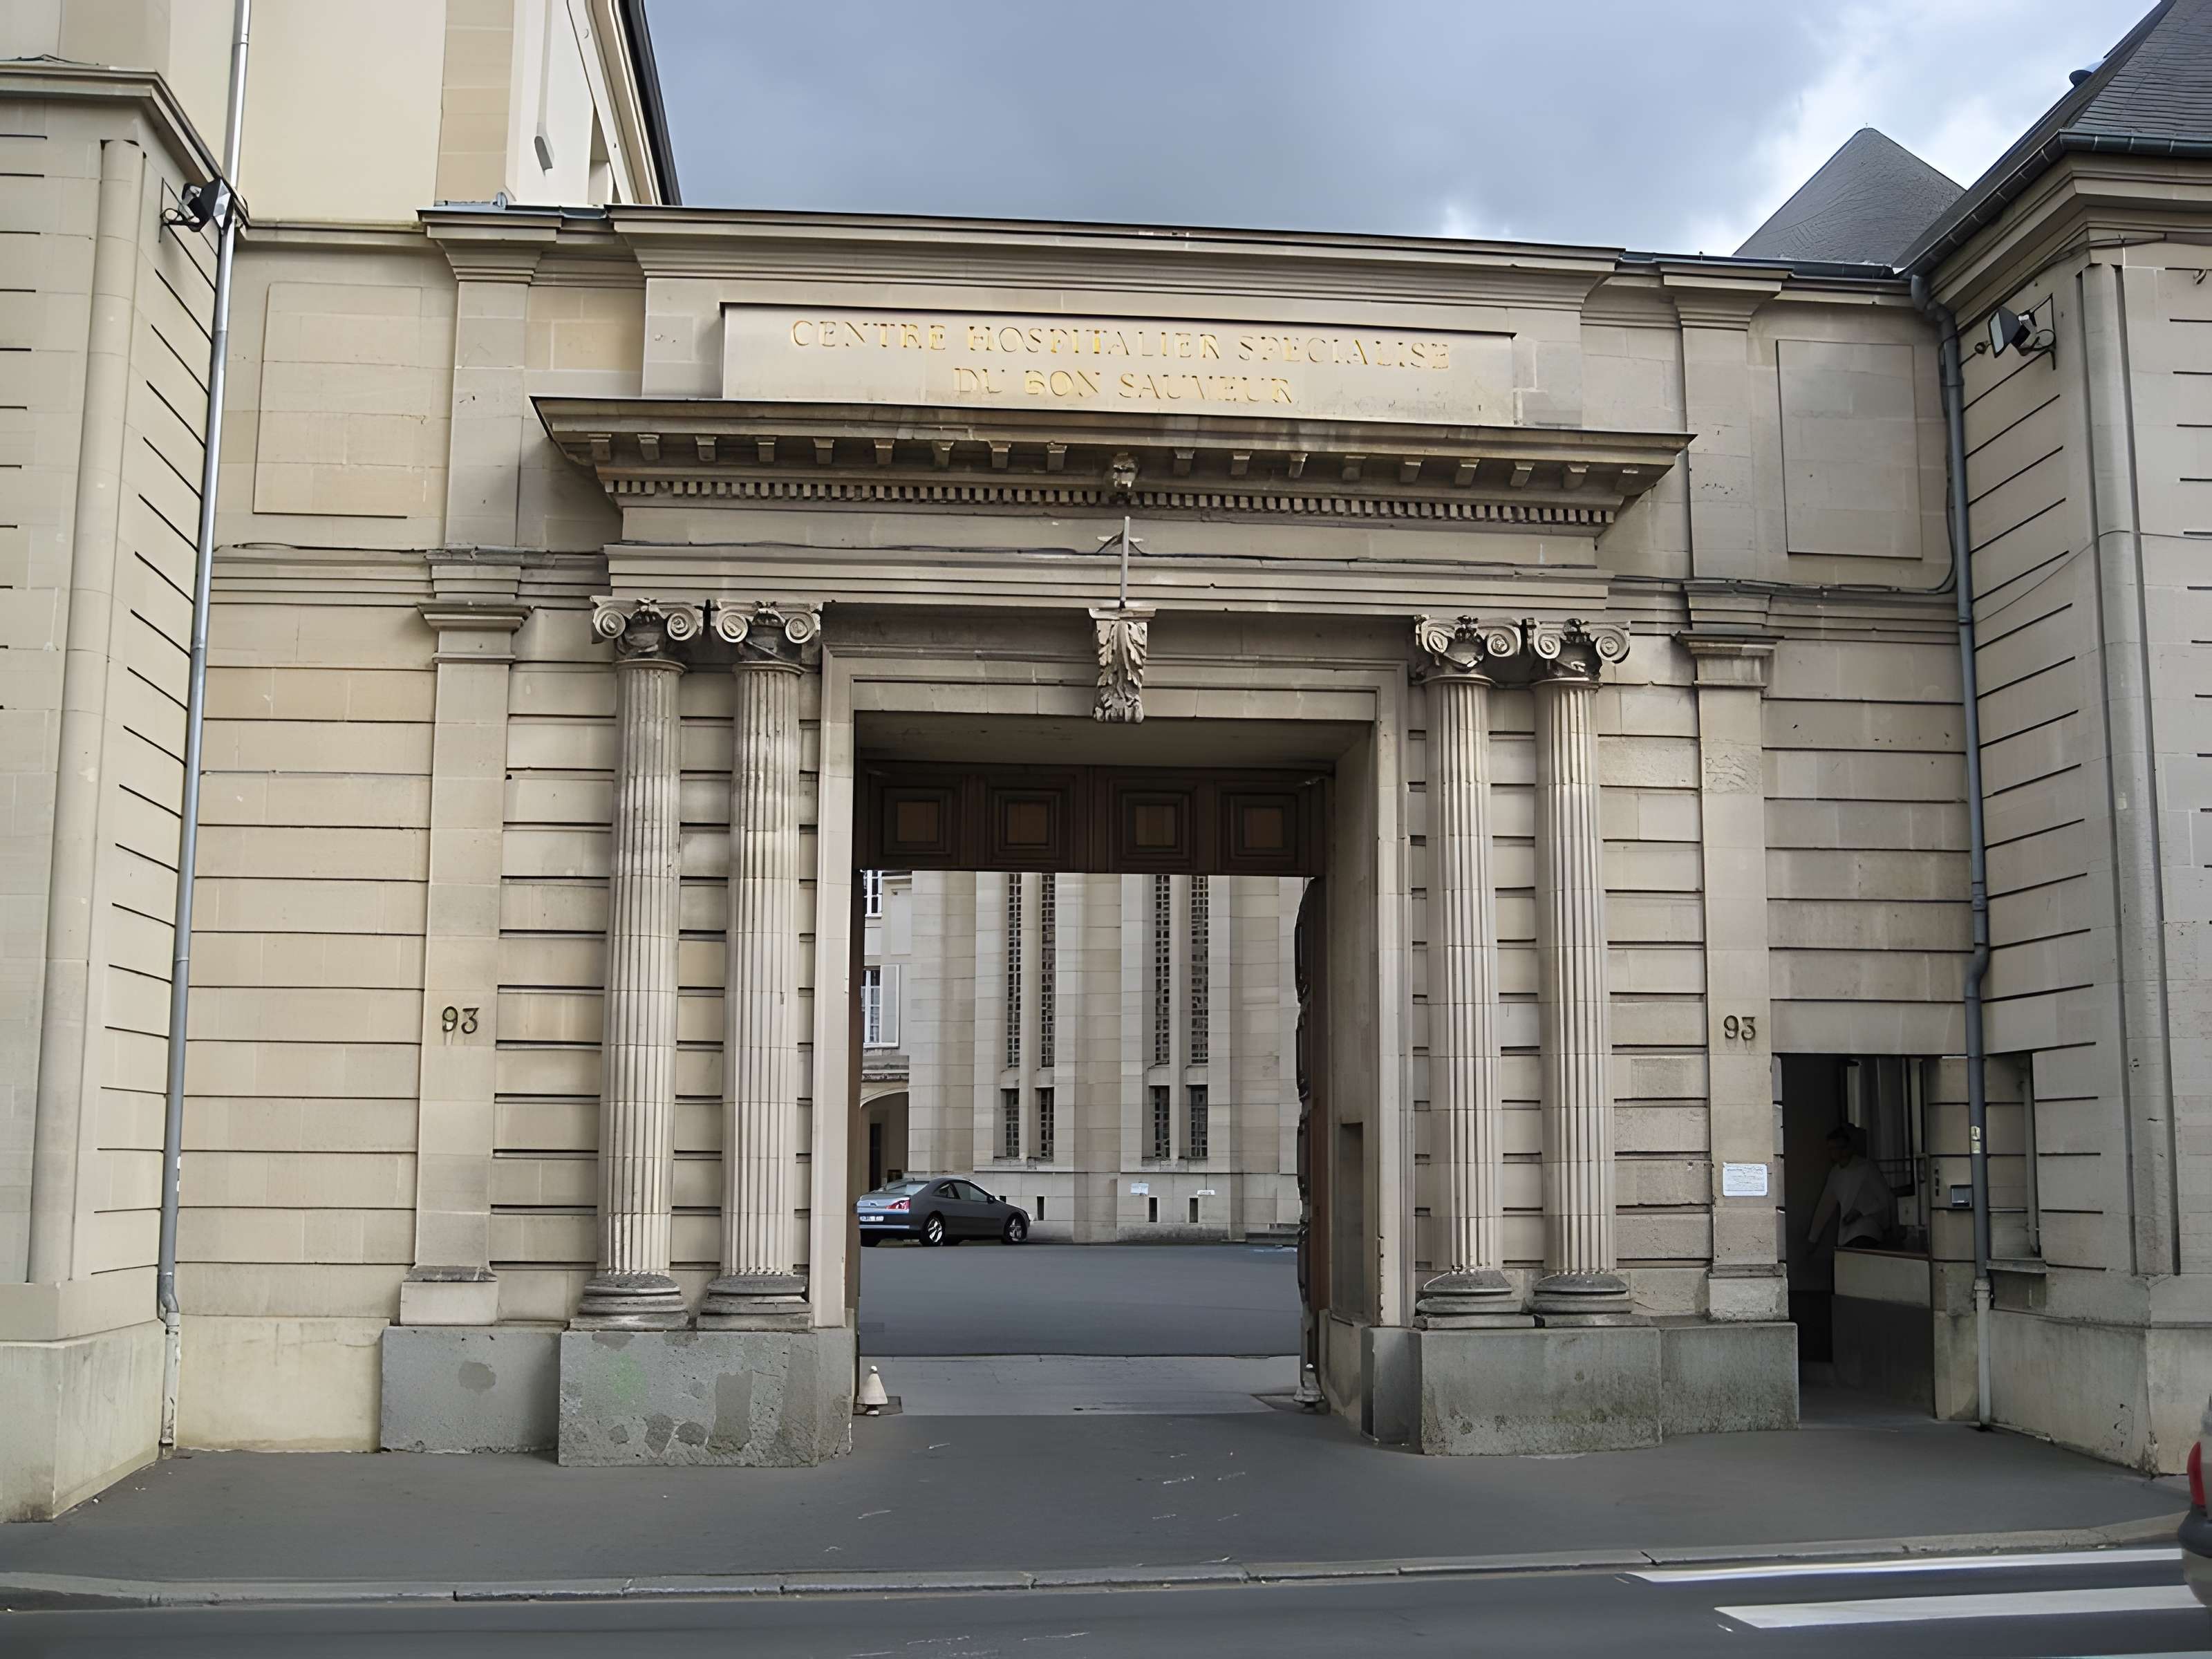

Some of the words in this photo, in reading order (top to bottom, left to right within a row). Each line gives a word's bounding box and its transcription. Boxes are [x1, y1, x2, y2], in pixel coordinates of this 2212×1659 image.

[790, 320, 946, 351] CENTRE
[968, 326, 1220, 359] HOSPITALIER
[1024, 370, 1100, 398] BON
[1118, 373, 1293, 404] SAUVEUR
[442, 1006, 480, 1035] 93
[1723, 1015, 1756, 1041] 93
